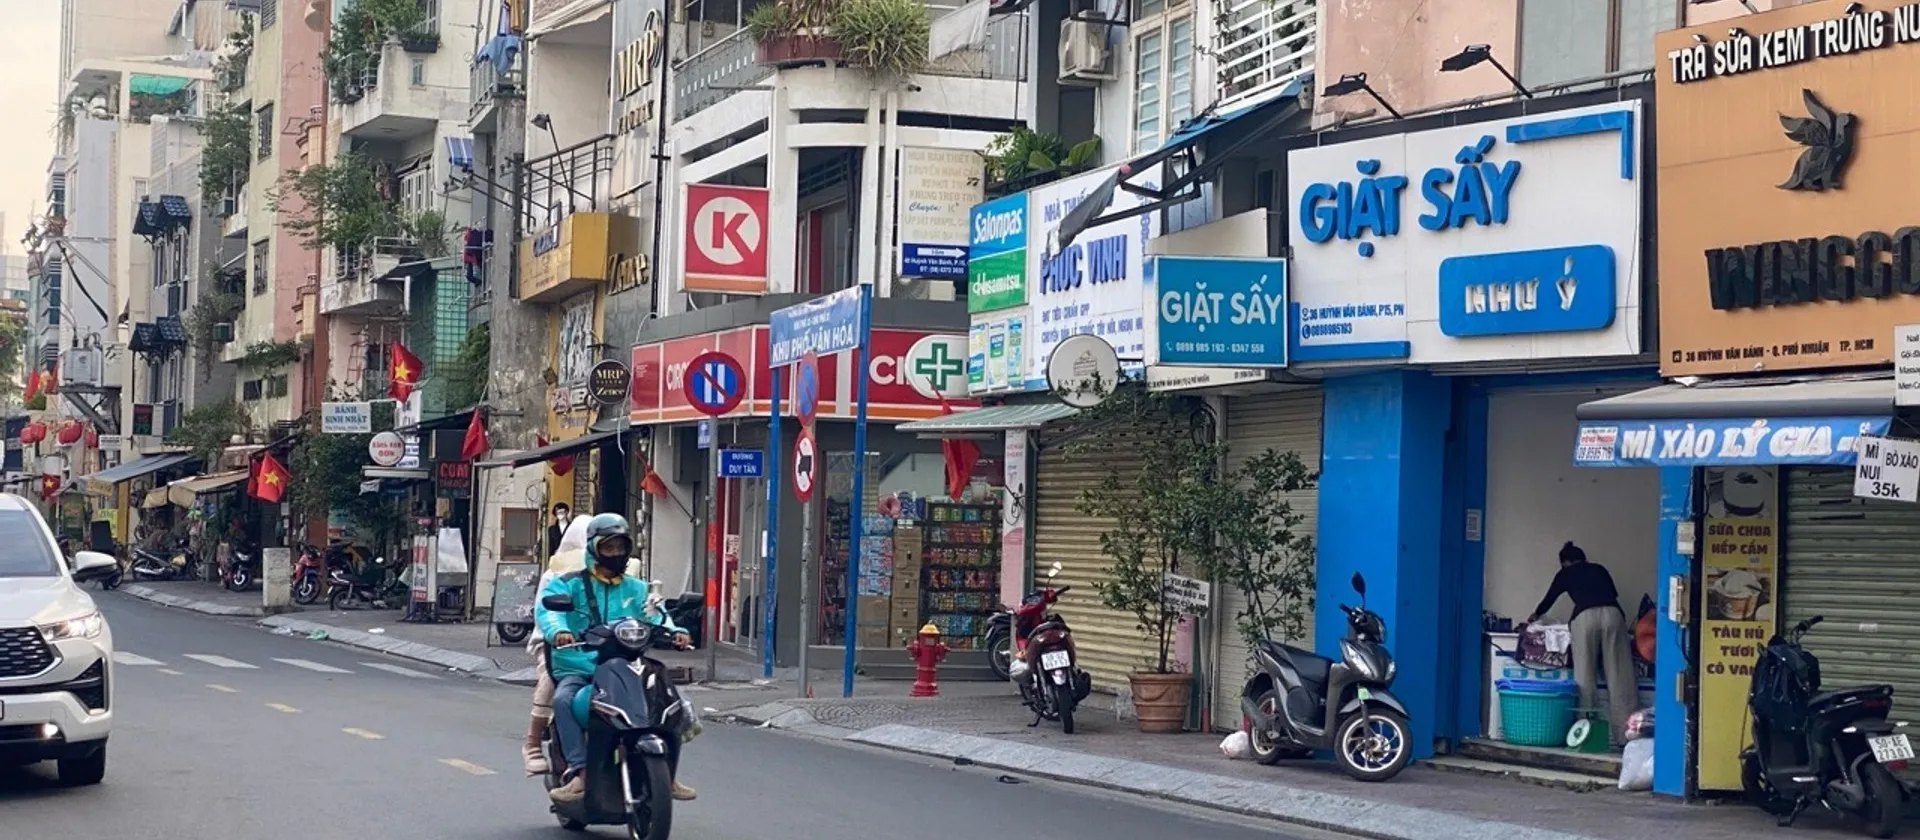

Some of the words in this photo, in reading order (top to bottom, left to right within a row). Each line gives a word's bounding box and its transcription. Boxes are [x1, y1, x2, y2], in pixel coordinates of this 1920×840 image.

[1668, 34, 1707, 83] TRÀ
[1713, 27, 1752, 77] SỮA
[1759, 24, 1805, 70] KEM
[1810, 1, 1885, 57] TRỨNG
[1300, 158, 1409, 258] GIẶT
[1418, 135, 1522, 232] SẤY
[973, 207, 1022, 244] Salonpas
[1087, 234, 1128, 285] VINH
[1465, 276, 1540, 315] NHƯ
[1556, 255, 1579, 310] Ý
[1161, 281, 1225, 332] GIẶT
[1230, 274, 1282, 325] SẤY
[772, 341, 790, 363] KHU
[832, 319, 854, 348] HÓA
[1685, 351, 1696, 362] 36
[1697, 348, 1723, 362] HUỲNH
[1743, 344, 1764, 358] BÁNH
[1782, 342, 1799, 356] PHÚ
[1801, 340, 1830, 356] NHUẬN
[1840, 340, 1852, 351] TP.
[1854, 339, 1874, 351] HCM
[596, 369, 625, 380] MRP
[334, 405, 357, 414] BÁNH
[325, 415, 343, 424] SINH
[1621, 424, 1657, 459] MÌ
[1659, 423, 1716, 458] XÀO
[1769, 424, 1832, 456] GIA
[1865, 441, 1880, 458] MÌ
[728, 464, 742, 474] DUY
[1899, 452, 1919, 469] XÀO
[1859, 465, 1881, 480] NUI
[1871, 481, 1901, 498] 35k
[1708, 522, 1734, 536] SỮA
[1737, 525, 1771, 537] CHUA
[1711, 542, 1737, 554] NẾP
[1720, 645, 1754, 657] TƯƠI
